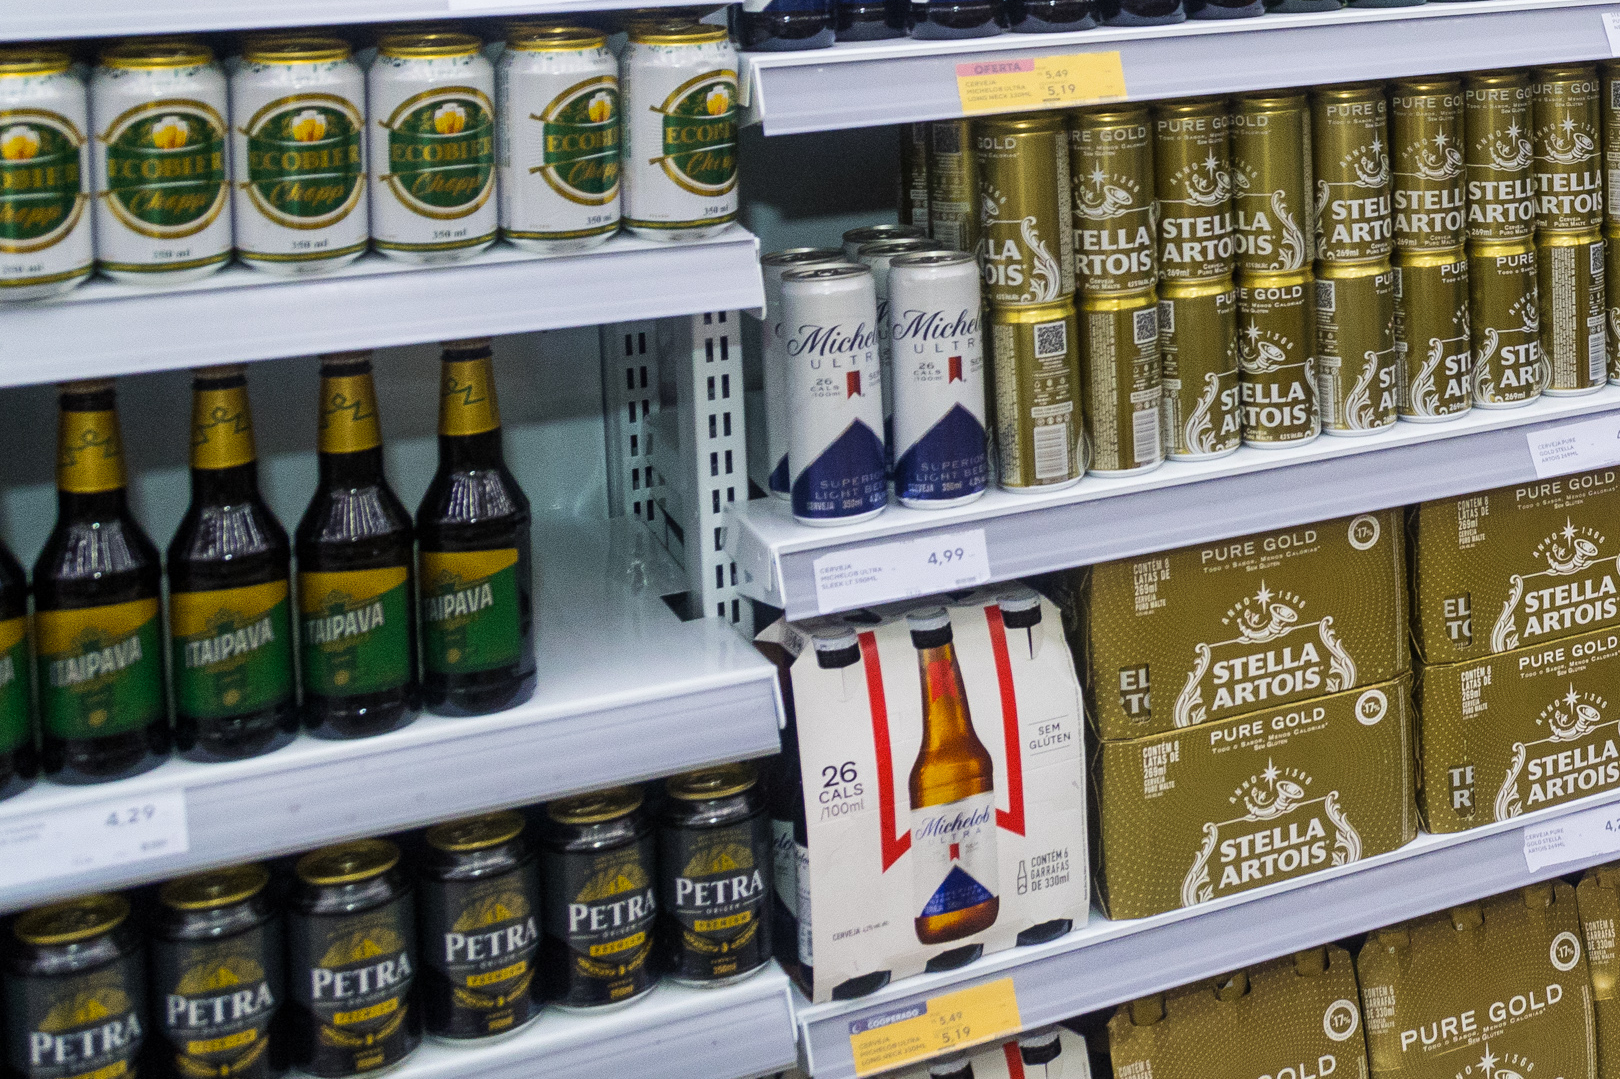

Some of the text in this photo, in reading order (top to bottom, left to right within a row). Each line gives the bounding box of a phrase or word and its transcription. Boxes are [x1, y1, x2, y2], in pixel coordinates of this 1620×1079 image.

[974, 62, 1022, 75] OFERTA
[1045, 69, 1068, 80] 5,49
[1047, 83, 1076, 96] 5,19
[1100, 126, 1147, 141] GOLD
[1471, 227, 1492, 237] 269ml
[927, 547, 965, 567] 4,99
[1200, 529, 1318, 564] PURE GOLD
[1133, 560, 1163, 575] CONTÉM
[1134, 568, 1171, 586] LATAS DE
[1134, 582, 1158, 596] 269ml
[1518, 636, 1618, 669] PURE GOLD
[1213, 643, 1321, 685] STELLA
[1211, 666, 1323, 711] ARTOIS
[1029, 730, 1071, 750] GLÚTEN
[1038, 722, 1061, 736] SEM
[821, 761, 858, 789] 26
[818, 782, 864, 804] CALS
[820, 797, 865, 821] /100ml
[914, 804, 990, 839] Michelob
[1220, 816, 1327, 863] STELLA
[1031, 846, 1069, 868] CONTÉM 6
[1217, 843, 1329, 890] ARTOIS
[1030, 860, 1070, 880] GARRAFAS
[675, 868, 764, 907] PETRA
[1031, 873, 1070, 892] DE 330ml
[568, 888, 656, 933] PETRA
[445, 916, 538, 962] PETRA
[165, 980, 275, 1027] PETRA
[29, 1012, 142, 1066] PETRA
[941, 1026, 971, 1044] 5,19
